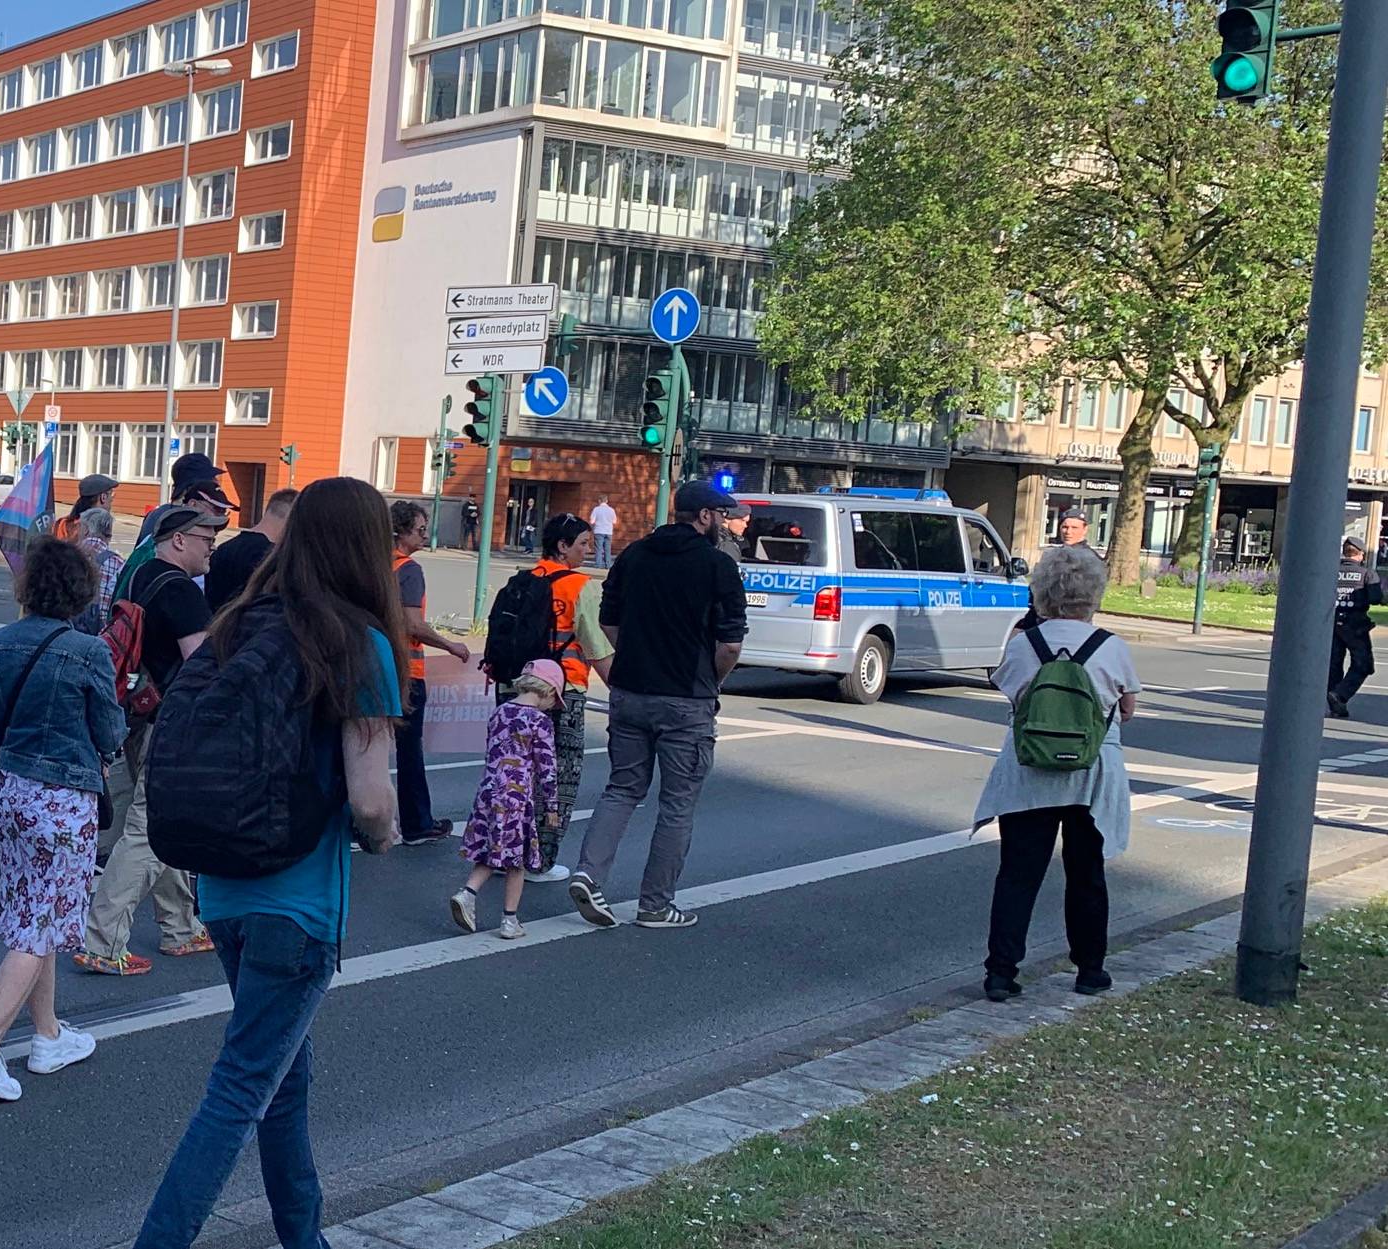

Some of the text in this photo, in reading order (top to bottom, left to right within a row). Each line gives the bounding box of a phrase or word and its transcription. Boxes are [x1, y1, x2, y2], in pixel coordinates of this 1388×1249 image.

[414, 180, 452, 196] Deutsche
[467, 293, 549, 306] Stratmanns Theater
[479, 321, 541, 336] Kennedyplatz
[482, 354, 504, 366] WDR
[749, 573, 817, 591] POLIZEI
[927, 590, 963, 608] POLIZEI
